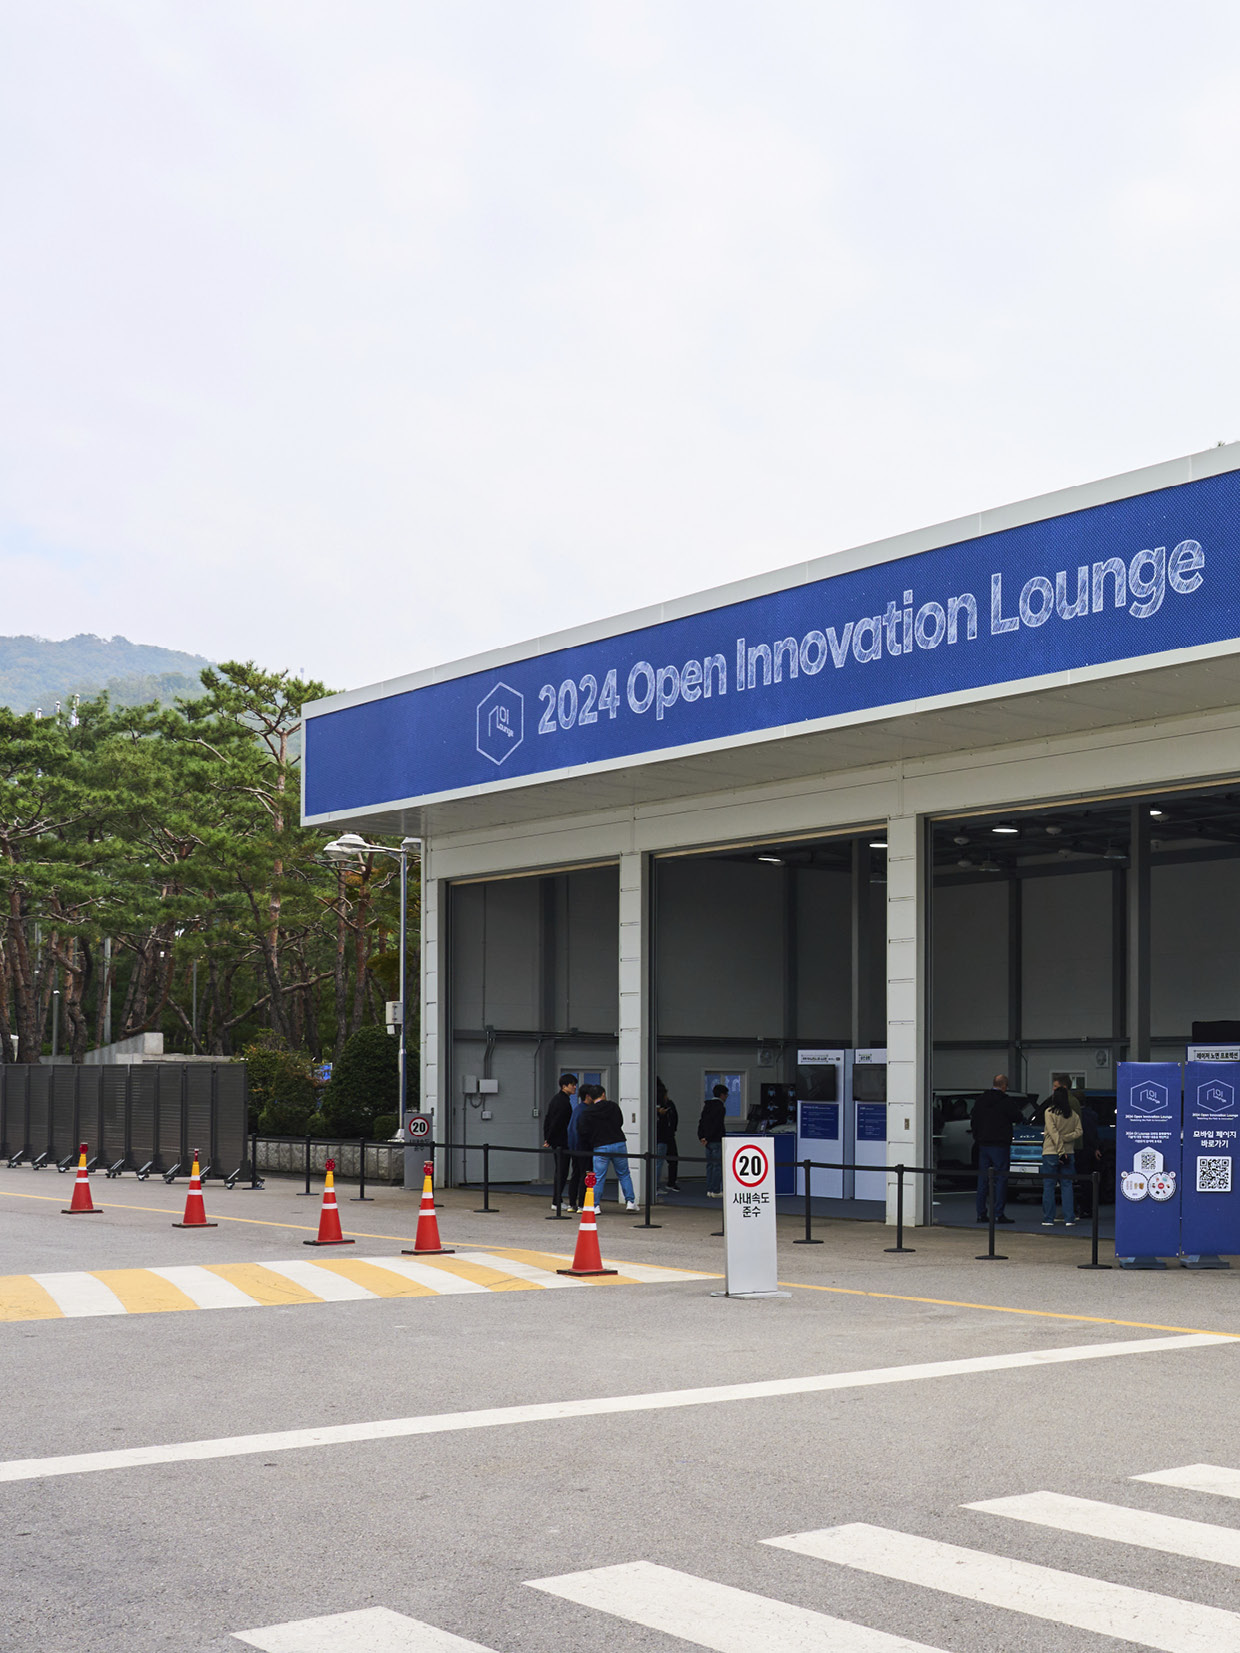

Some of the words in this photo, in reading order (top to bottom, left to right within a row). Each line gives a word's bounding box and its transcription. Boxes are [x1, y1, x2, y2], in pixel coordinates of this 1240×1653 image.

[538, 668, 620, 735] 2024
[627, 654, 727, 720] Open
[735, 590, 978, 692] Innovation
[991, 539, 1205, 635] Lounge
[412, 1122, 426, 1133] 20
[1193, 1130, 1214, 1138] 모바일
[1215, 1130, 1237, 1139] 페이지
[1200, 1139, 1229, 1148] 바로가기
[738, 1155, 762, 1176] 20
[733, 1192, 770, 1204] 사내속도
[742, 1206, 761, 1218] 준수
